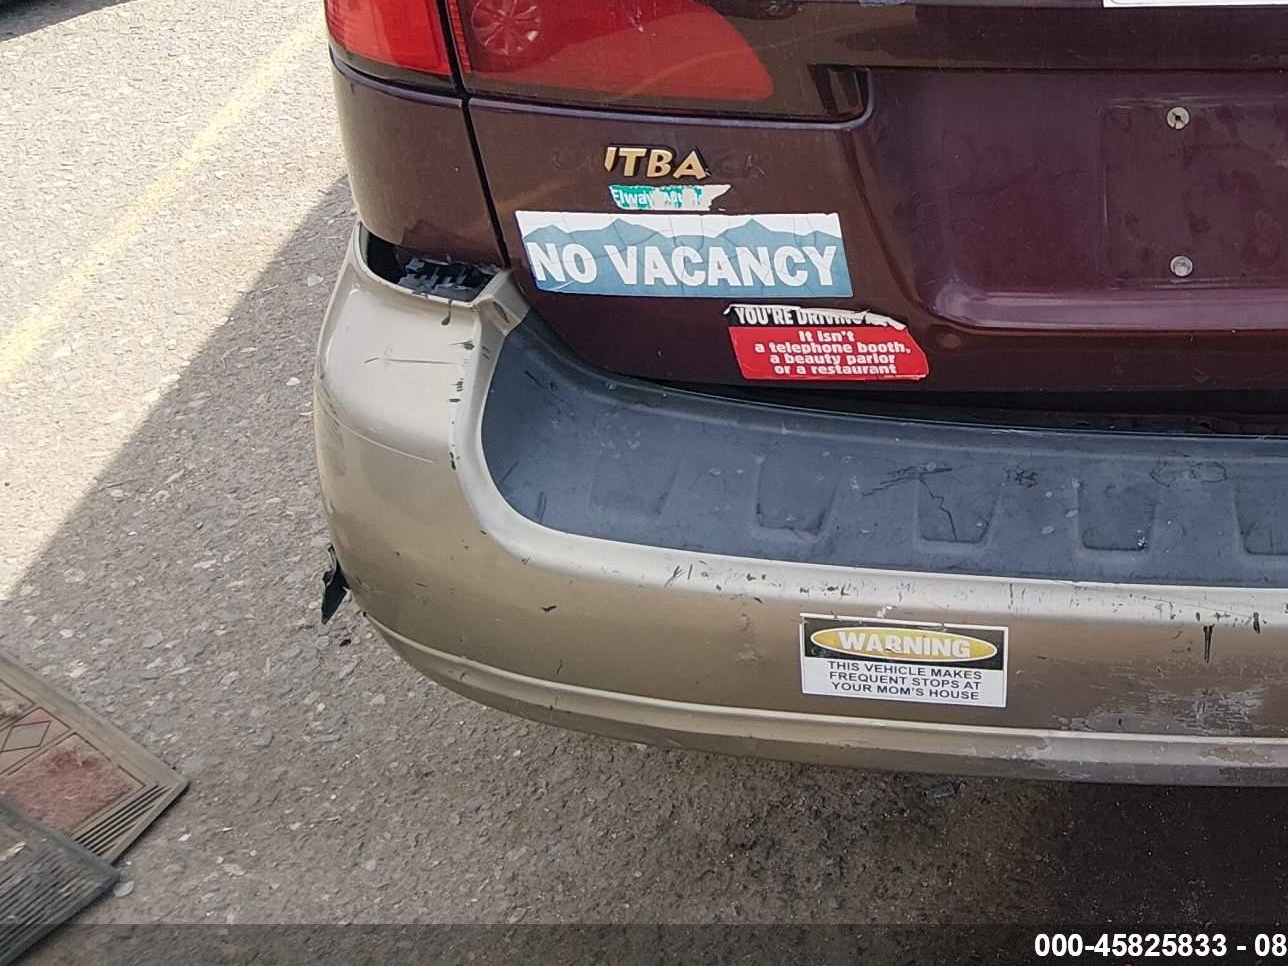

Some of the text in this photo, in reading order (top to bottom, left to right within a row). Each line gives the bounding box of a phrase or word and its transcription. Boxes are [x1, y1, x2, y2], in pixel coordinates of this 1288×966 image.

[526, 242, 837, 287] NO VACANCY
[734, 307, 794, 325] YOU'RE
[799, 330, 855, 342] It isn't
[755, 344, 766, 353] a
[769, 342, 853, 357] telephone
[770, 353, 896, 367] a beauty parlor
[774, 364, 897, 375] or a restaurant
[837, 631, 971, 659] WARNING
[828, 661, 982, 680] THIS VEHICLE MAKES
[829, 672, 982, 690] FREQUENT STOPS AT
[831, 682, 980, 700] YOUR MOM'S HOUSE
